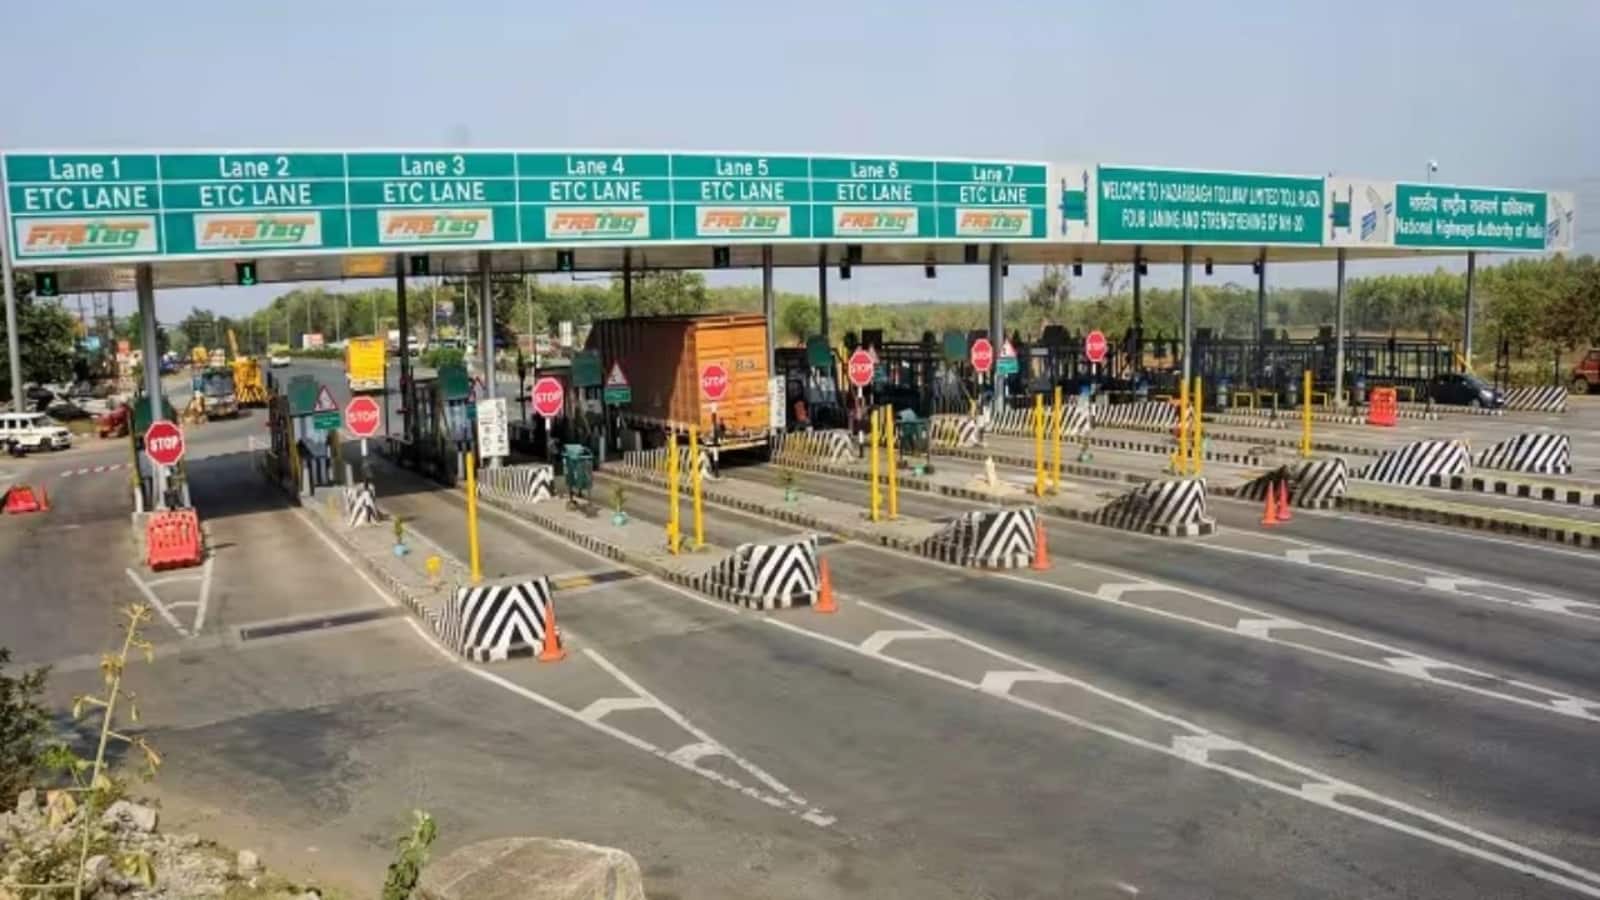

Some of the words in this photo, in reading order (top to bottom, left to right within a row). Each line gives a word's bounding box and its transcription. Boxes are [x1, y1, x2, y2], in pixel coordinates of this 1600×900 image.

[50, 158, 103, 180] Lane
[111, 157, 120, 178] 1
[220, 157, 269, 178] Lane
[276, 156, 290, 176] 2
[401, 156, 448, 176] Lane
[452, 156, 465, 175] 3
[567, 158, 607, 176] Lane
[612, 157, 625, 174] 4
[715, 159, 755, 176] Lane
[758, 160, 768, 176] 5
[850, 161, 886, 178] Lane
[889, 162, 899, 178] 6
[972, 166, 1003, 182] Lane
[1005, 166, 1014, 182] 7
[24, 188, 74, 210] ETC
[82, 186, 148, 208] LANE
[201, 186, 244, 206] ETC
[252, 184, 311, 204] LANE
[384, 184, 424, 203] ETC
[431, 182, 485, 202] LANE
[551, 182, 586, 200] ETC
[592, 182, 642, 200] LANE
[701, 182, 734, 200] ETC
[740, 182, 784, 200] LANE
[837, 184, 867, 201] ETC
[873, 184, 912, 202] LANE
[960, 186, 987, 202] ETC
[992, 186, 1026, 202] LANE
[1102, 181, 1145, 200] WELCOME
[1147, 182, 1158, 202] TO
[1249, 187, 1280, 206] LIMITED
[1122, 208, 1146, 228] FOUR
[1182, 210, 1200, 230] AND
[1268, 213, 1278, 232] OF
[1395, 216, 1433, 236] National
[1436, 218, 1476, 240] Highways
[1477, 220, 1514, 241] Authority
[1515, 222, 1525, 238] of
[704, 376, 725, 388] STOP
[535, 390, 561, 404] STOP
[350, 410, 378, 423] STOP
[150, 435, 179, 452] STOP
